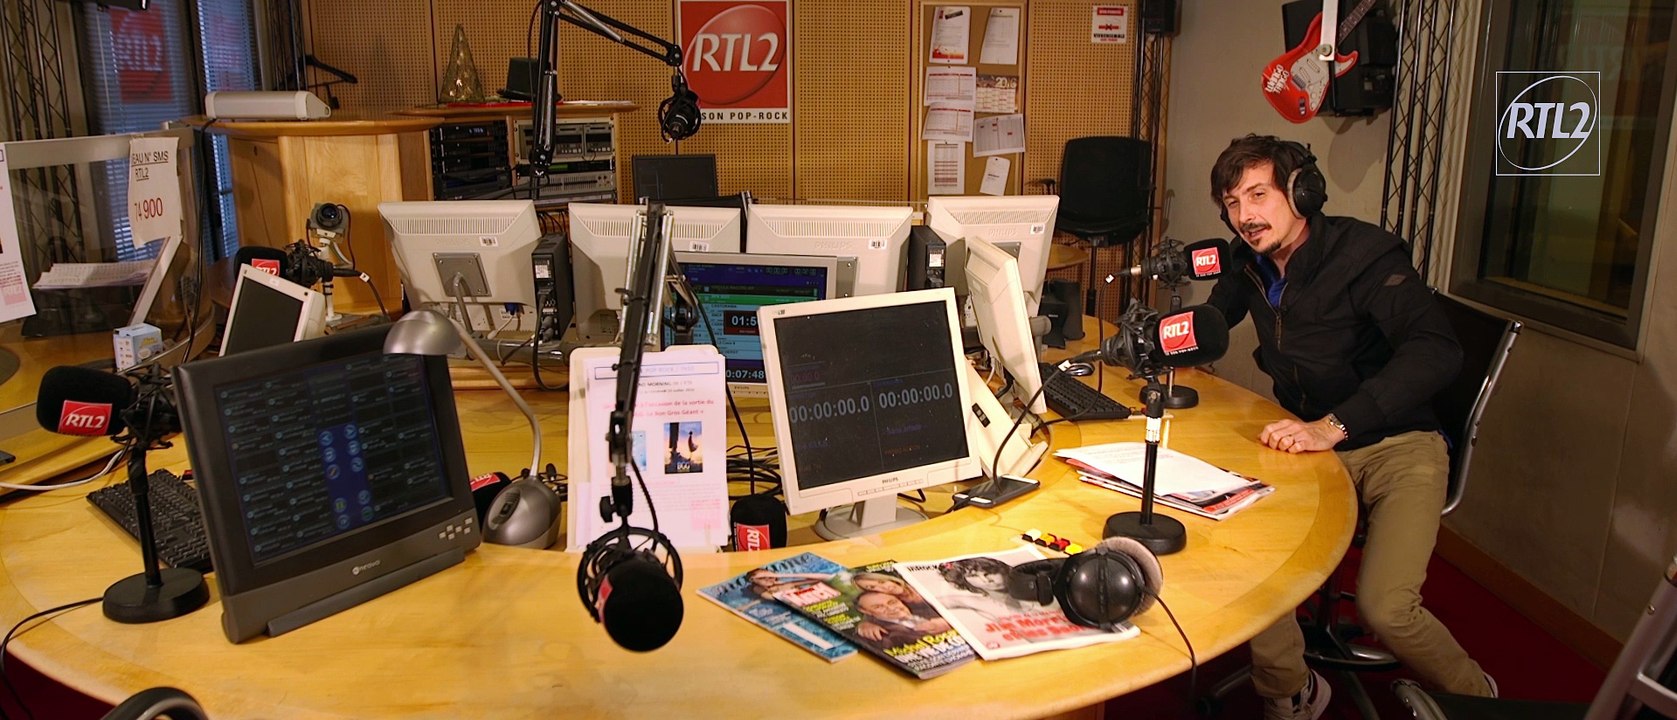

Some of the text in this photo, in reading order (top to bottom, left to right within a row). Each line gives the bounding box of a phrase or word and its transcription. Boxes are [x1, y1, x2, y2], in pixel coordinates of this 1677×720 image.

[692, 32, 779, 72] RTL2
[701, 111, 788, 120] SON POP-ROCK
[153, 150, 169, 162] SMS
[1195, 254, 1216, 267] RTL2
[1162, 321, 1190, 340] RTL2
[878, 382, 954, 409] 00:00:00.0
[789, 395, 870, 424] 00:00:00.0
[65, 413, 106, 429] RTL2
